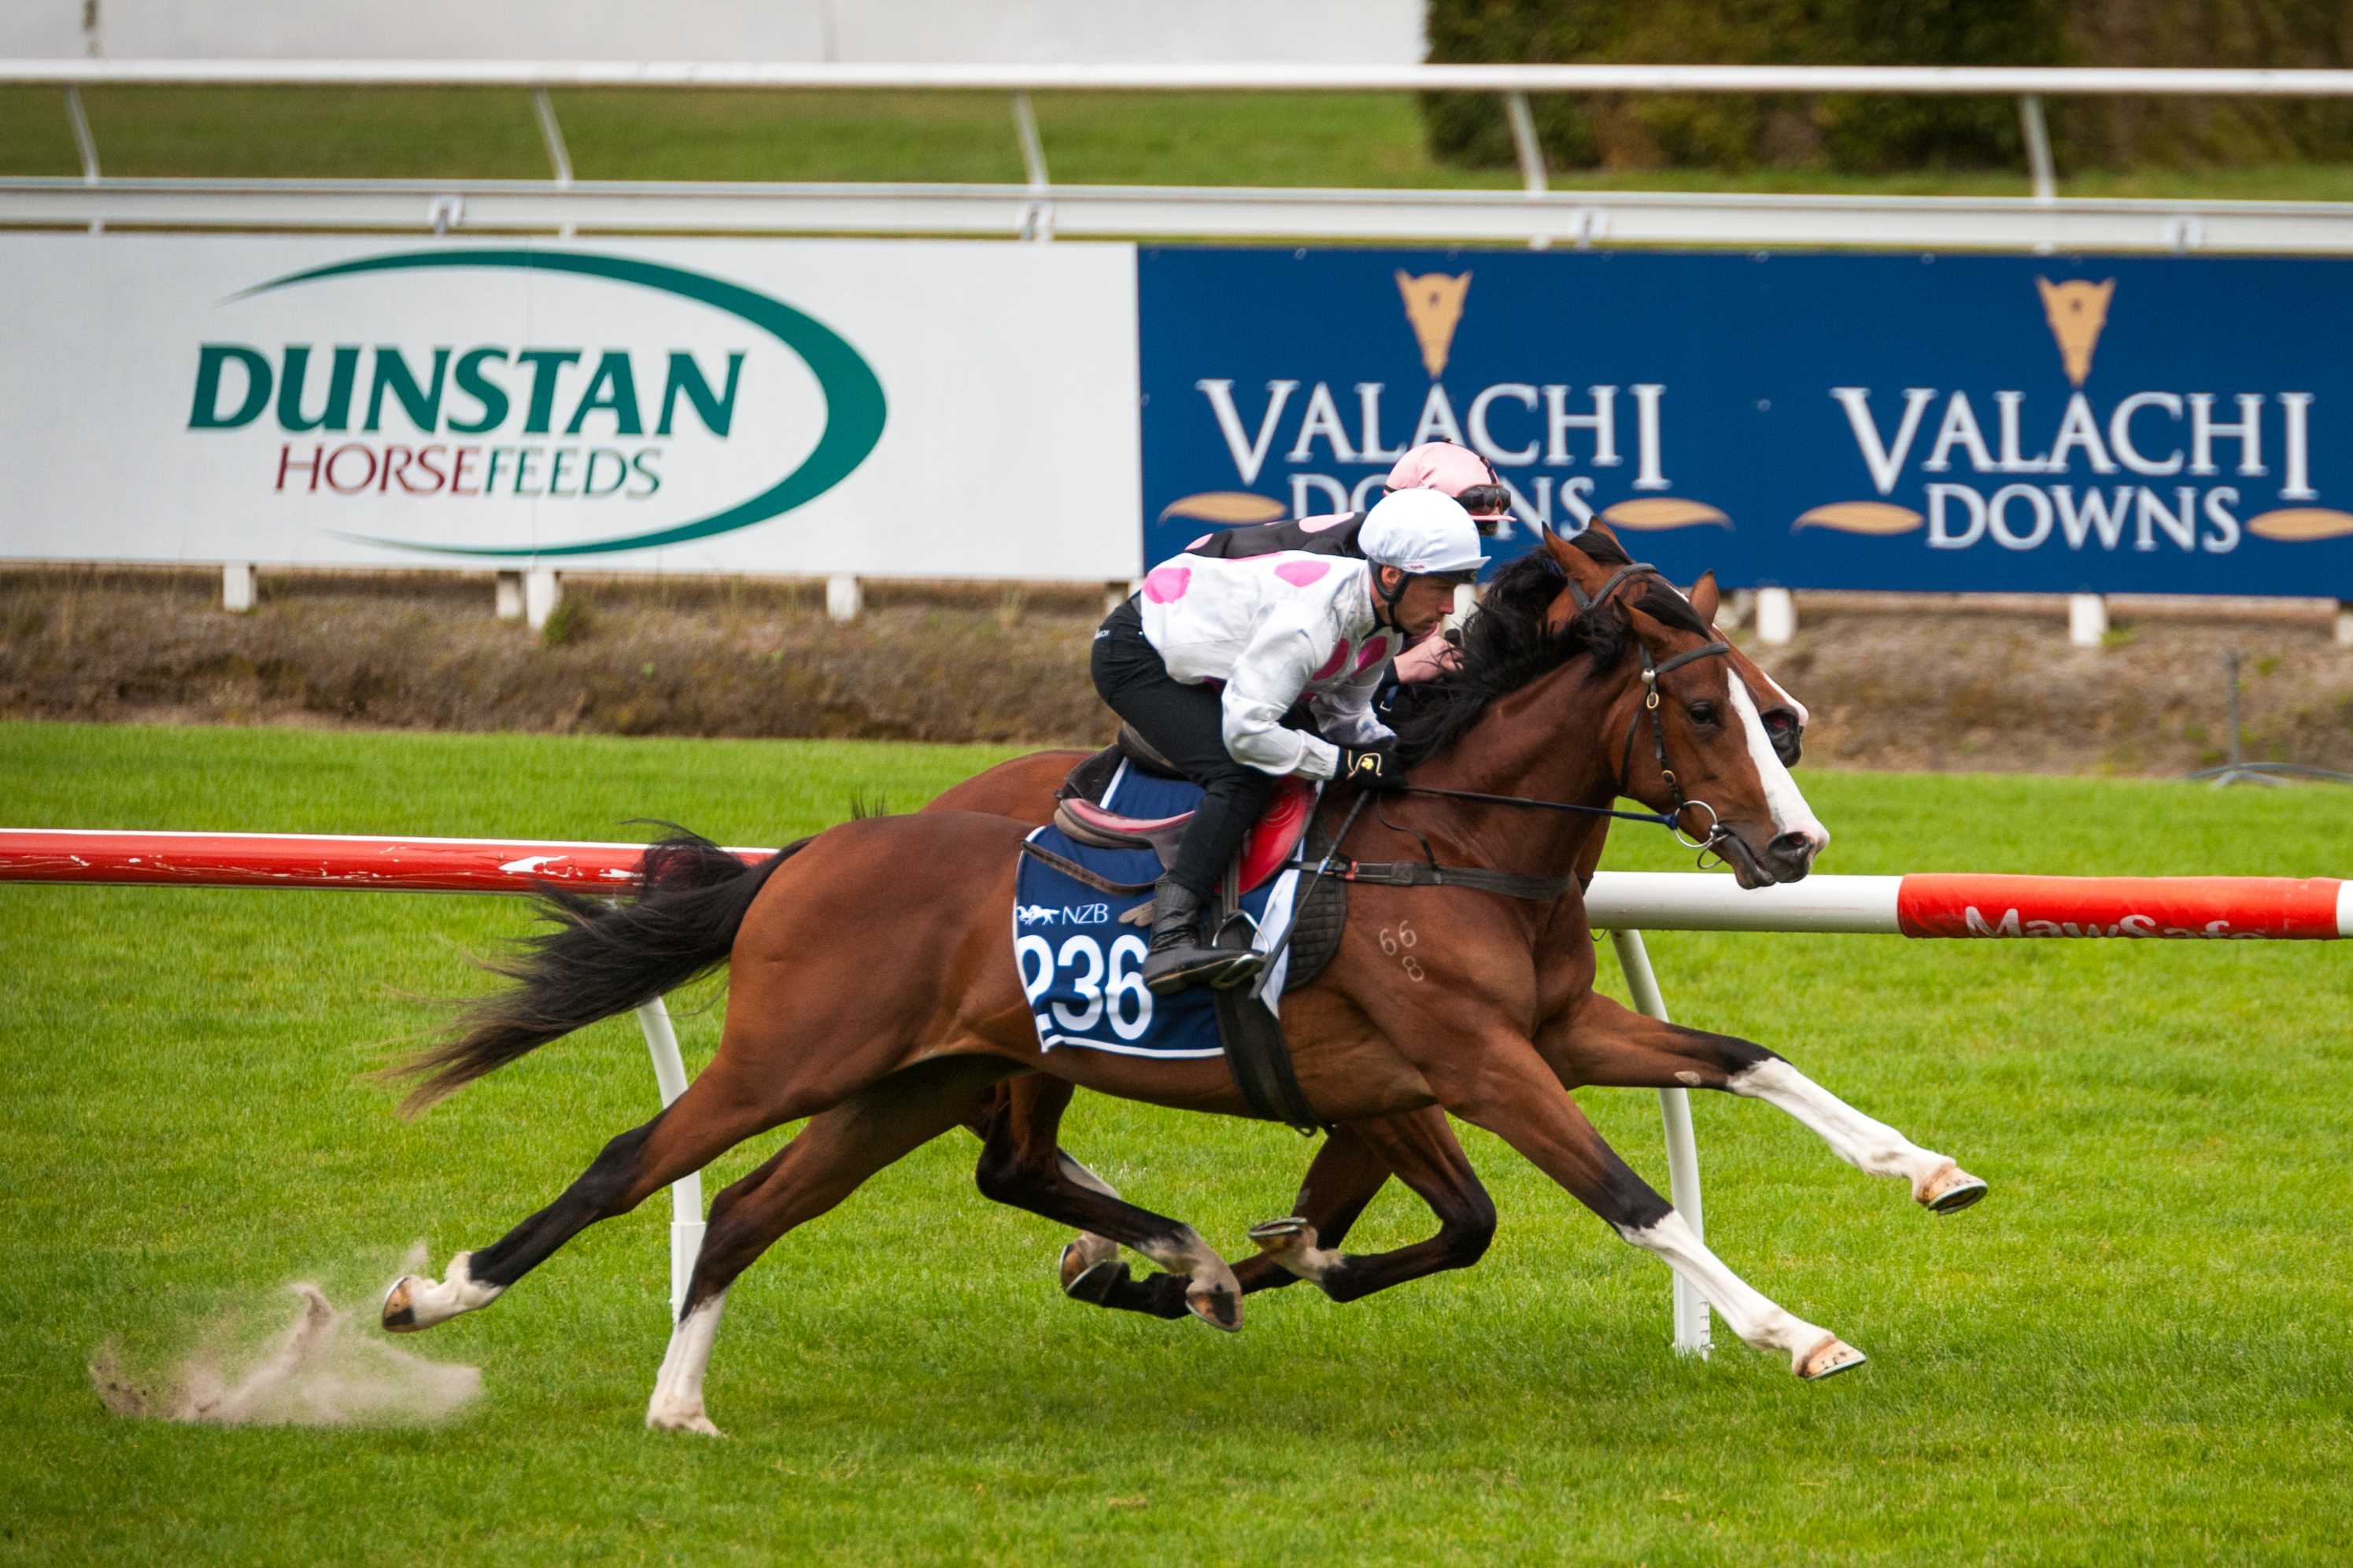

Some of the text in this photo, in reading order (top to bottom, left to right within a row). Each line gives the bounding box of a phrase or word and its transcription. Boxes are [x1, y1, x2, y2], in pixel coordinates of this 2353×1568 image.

[187, 341, 748, 439] DUNSTAN
[1195, 378, 1672, 491] VALACHI
[1829, 386, 2318, 500] VALACHI
[274, 442, 663, 499] HORSEFEEDS
[1286, 473, 1596, 541] DNS
[1923, 482, 2241, 553] DOWNS
[1062, 903, 1109, 925] NZB
[1379, 919, 1417, 955] 66
[1965, 906, 2267, 939] MawSf
[1016, 934, 1154, 1040] 236
